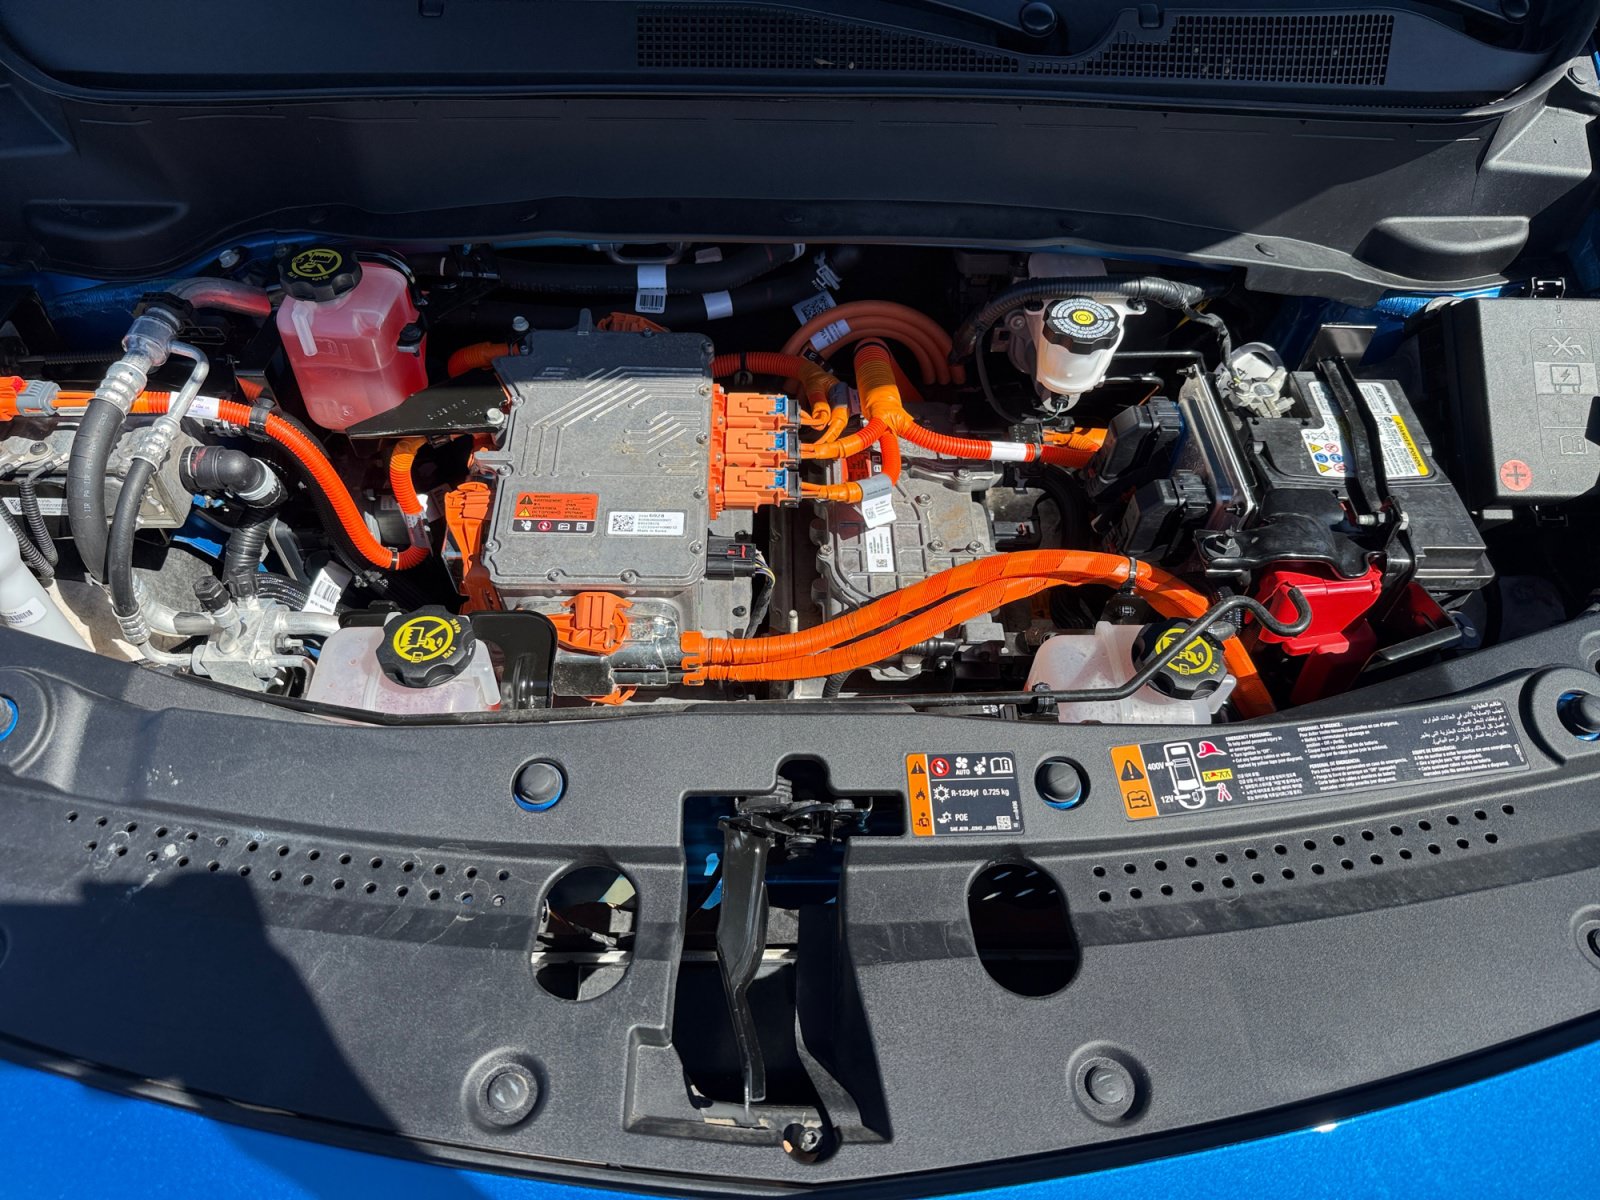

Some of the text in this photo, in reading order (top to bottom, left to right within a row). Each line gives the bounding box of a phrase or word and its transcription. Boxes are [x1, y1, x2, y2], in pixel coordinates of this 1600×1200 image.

[1398, 423, 1422, 467] DANGER POISON
[1147, 761, 1164, 771] 400V
[1161, 794, 1174, 804] 12V
